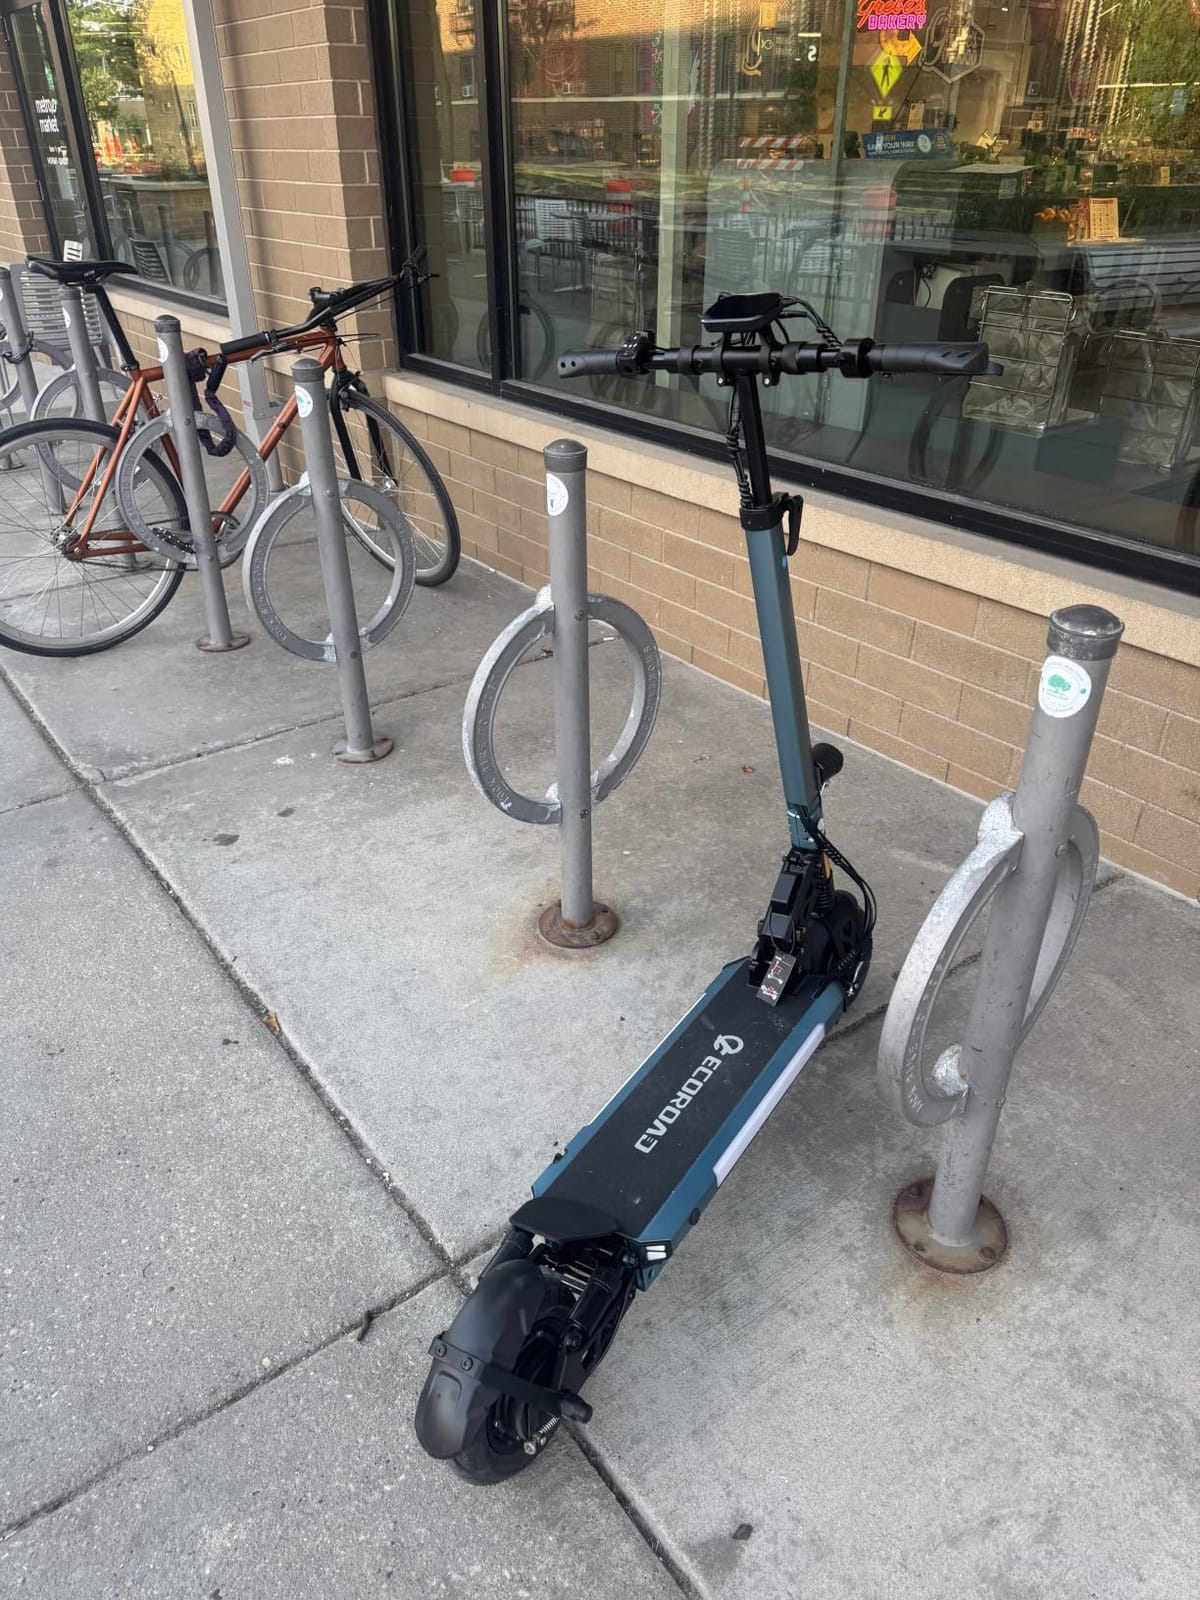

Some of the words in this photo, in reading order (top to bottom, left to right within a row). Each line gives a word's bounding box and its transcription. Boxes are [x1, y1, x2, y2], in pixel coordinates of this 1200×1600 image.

[868, 14, 927, 30] BAKERY
[39, 115, 60, 133] market
[634, 1055, 721, 1154] ECOROAD
